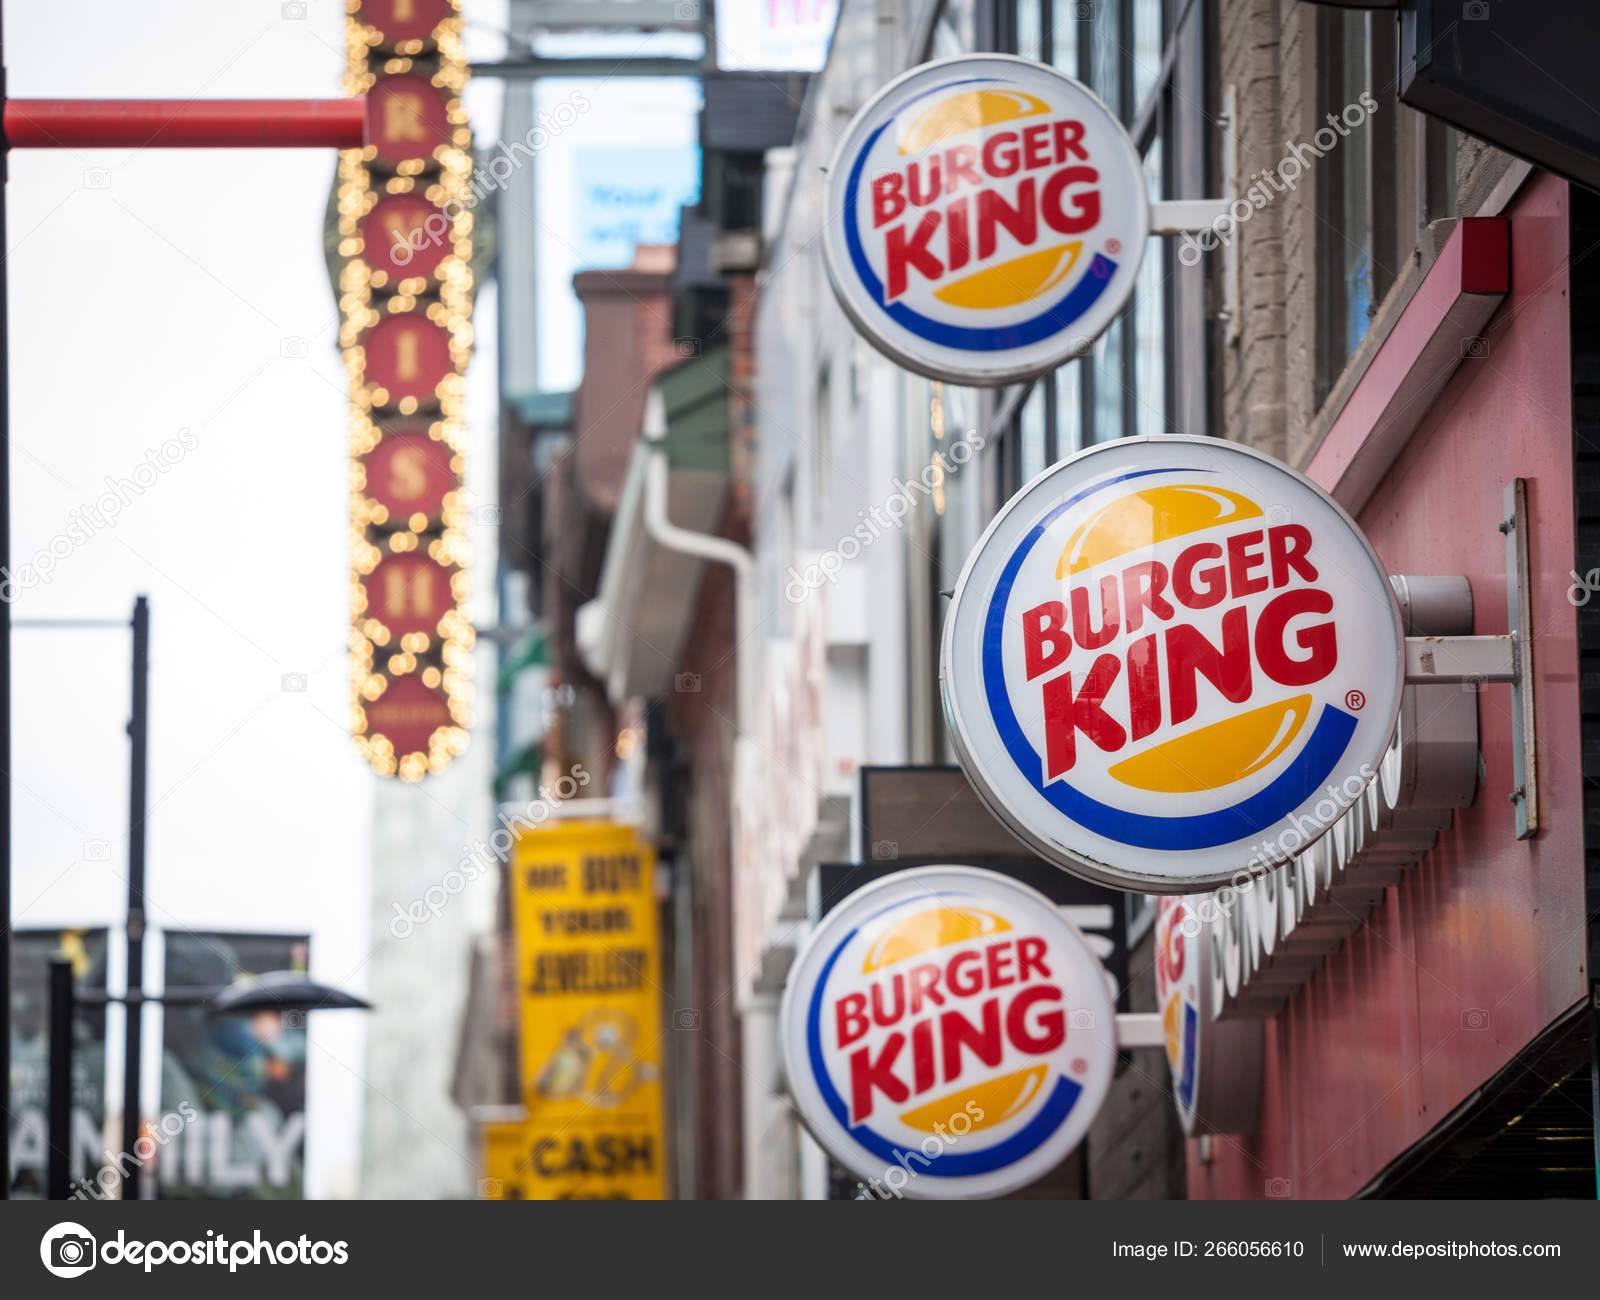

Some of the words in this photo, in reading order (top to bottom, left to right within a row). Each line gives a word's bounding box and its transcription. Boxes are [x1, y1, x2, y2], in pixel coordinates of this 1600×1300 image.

[872, 118, 1089, 229] BURGER
[884, 164, 1102, 301] KING
[1022, 523, 1319, 682] BURGER
[1041, 588, 1339, 780] KING
[835, 935, 1053, 1050] BURGER
[849, 984, 1067, 1125] KING
[531, 1135, 655, 1178] CASH
